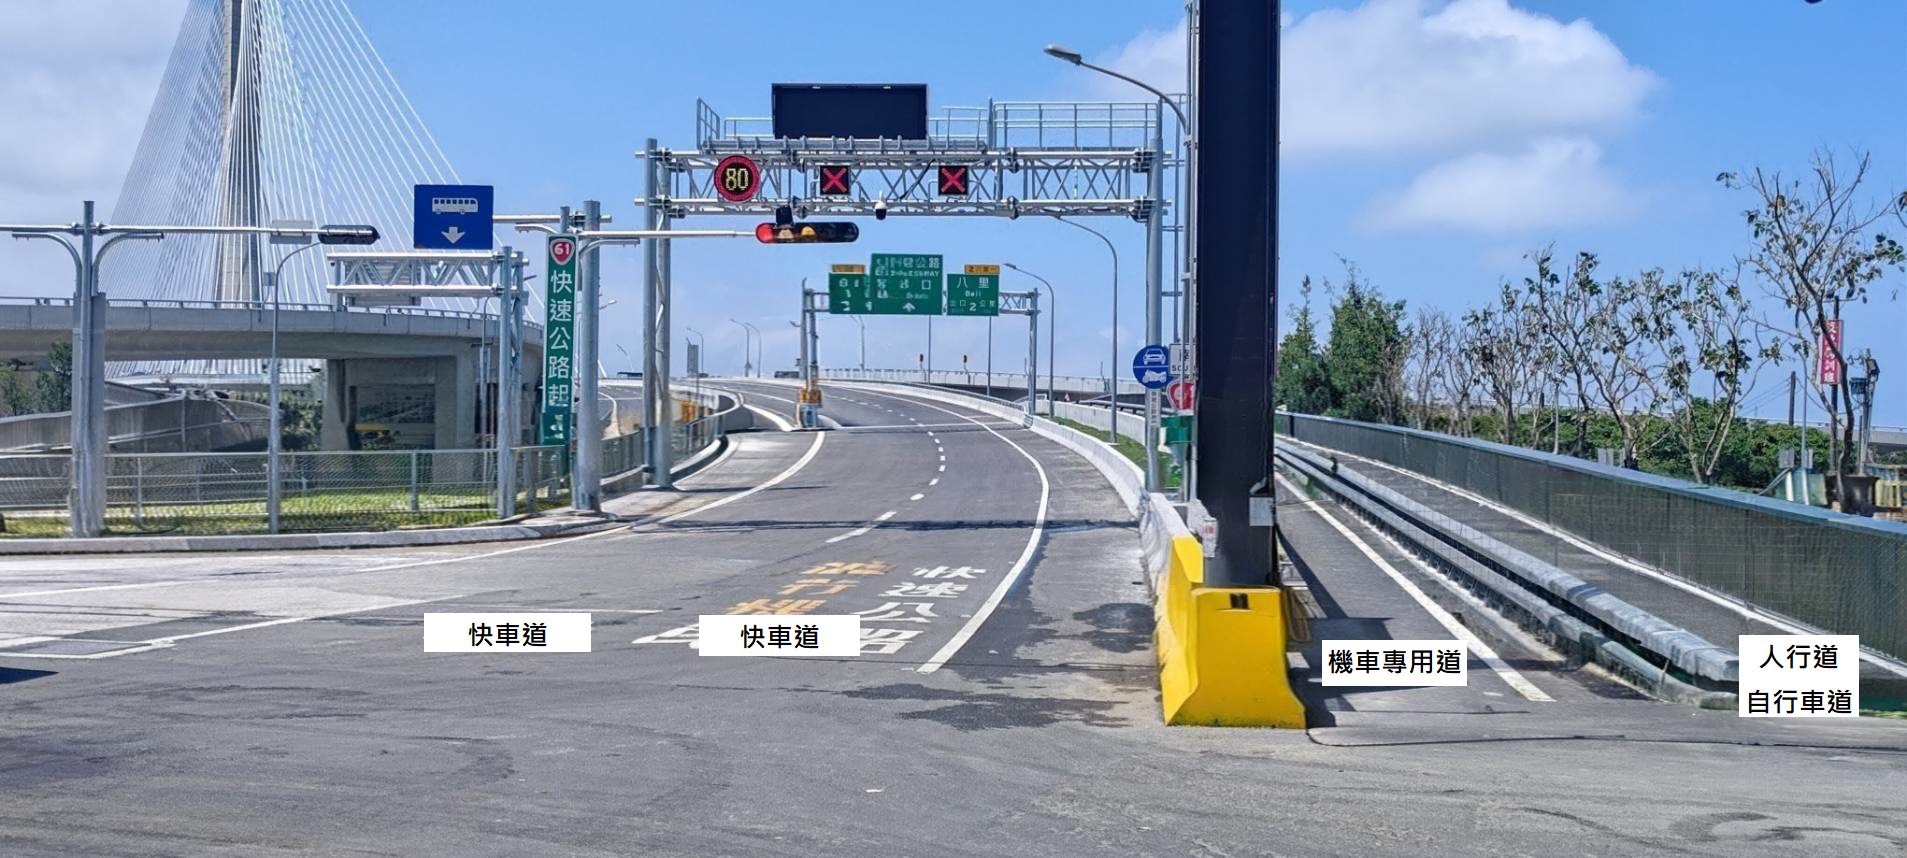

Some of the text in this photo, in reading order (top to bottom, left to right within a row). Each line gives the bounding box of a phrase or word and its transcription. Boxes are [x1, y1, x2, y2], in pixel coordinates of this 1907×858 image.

[725, 168, 749, 190] 80
[555, 243, 569, 255] 61
[956, 276, 989, 289] 八里
[969, 302, 977, 312] 2
